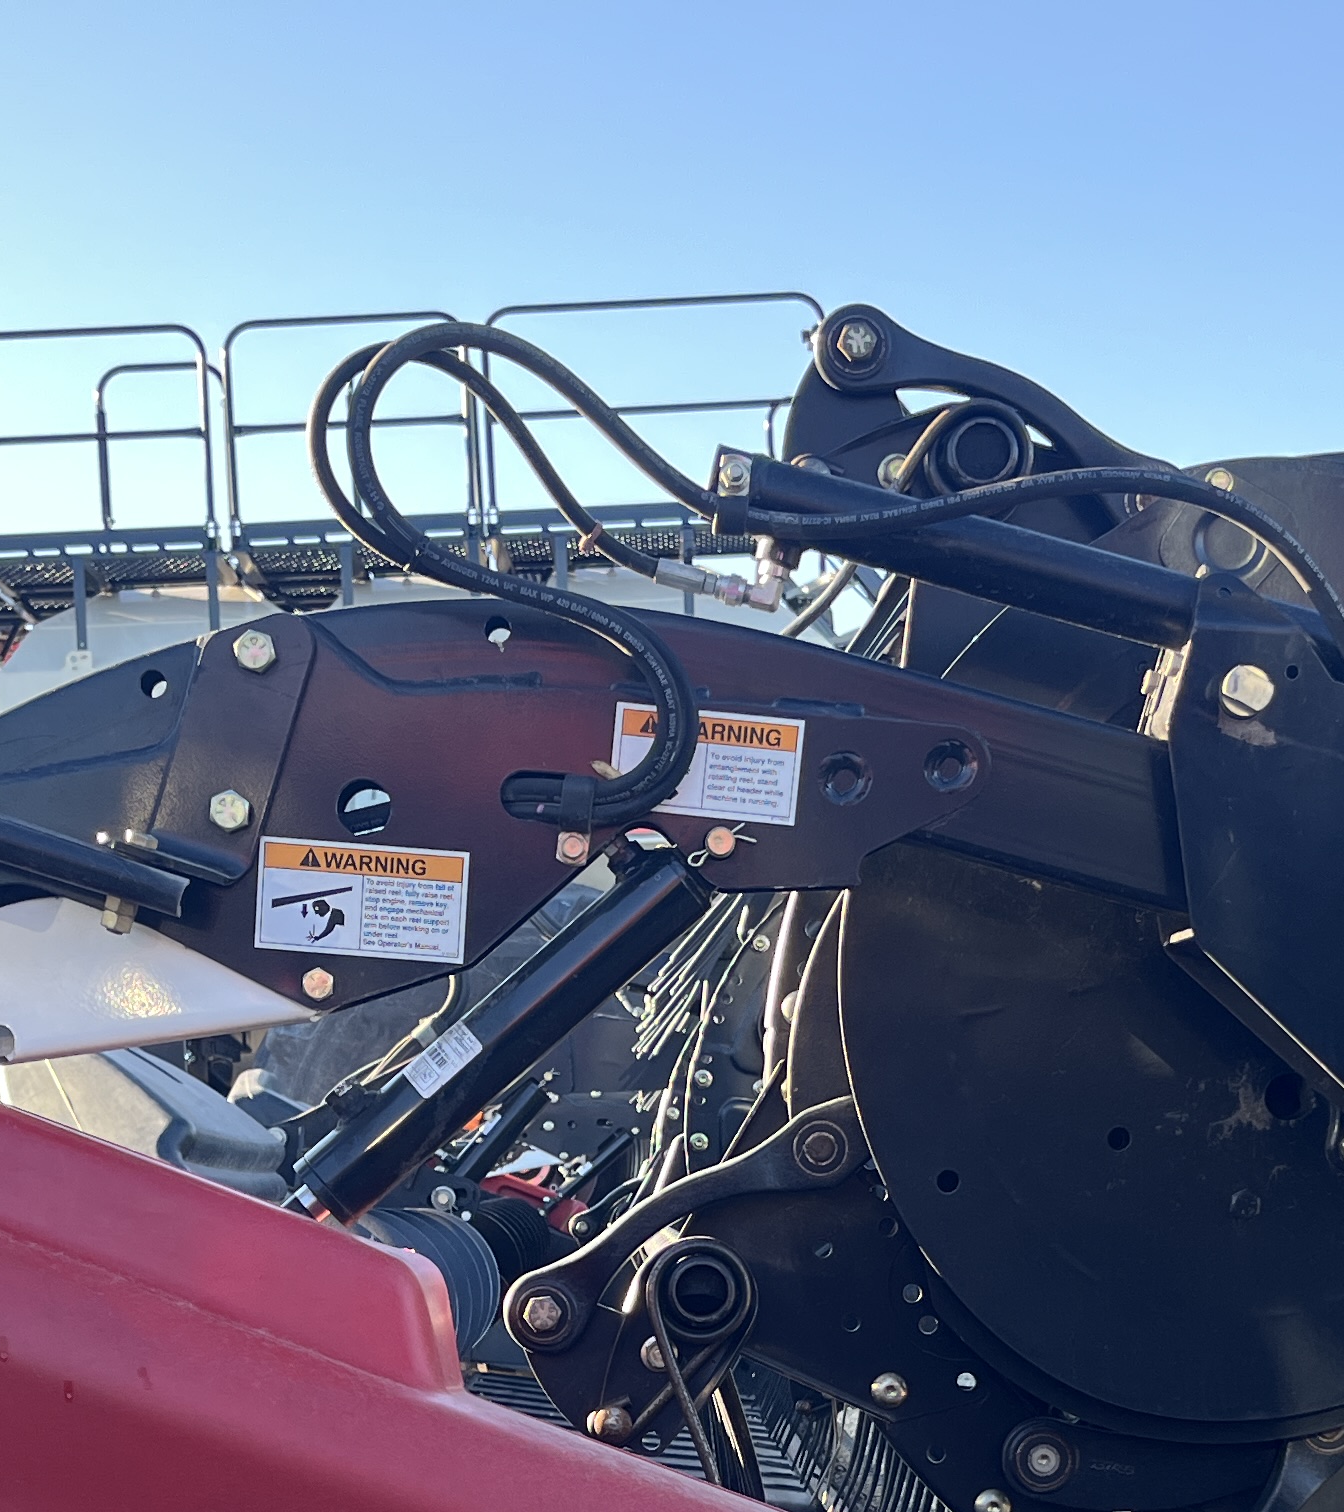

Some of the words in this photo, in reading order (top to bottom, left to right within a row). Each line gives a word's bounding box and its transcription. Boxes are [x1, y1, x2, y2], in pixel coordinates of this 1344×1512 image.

[1037, 475, 1055, 486] MAX
[860, 512, 879, 522] R2AT
[609, 621, 623, 635] PSI
[698, 722, 781, 747] ARNING
[711, 752, 720, 760] To
[722, 754, 742, 762] avoid
[744, 756, 765, 766] injury
[767, 758, 784, 766] from
[709, 764, 759, 774] entanglement
[708, 774, 737, 784] rotating
[757, 779, 778, 787] stand
[707, 783, 726, 791] clear
[737, 786, 763, 795] header
[764, 789, 784, 798] while
[706, 794, 738, 803] machine
[323, 851, 427, 876] WARNING
[366, 878, 374, 886] To
[376, 879, 395, 887] avoid
[396, 880, 417, 890] injury
[418, 882, 434, 890] from
[366, 887, 387, 895] raised
[405, 890, 420, 898] fully
[365, 896, 380, 904] stop
[379, 906, 404, 915] engage
[406, 908, 445, 917] mechanical
[423, 918, 450, 927] support
[363, 930, 383, 938] under
[378, 923, 400, 931] before
[402, 925, 429, 935] working
[363, 938, 376, 946] See
[377, 939, 413, 949] Operator's
